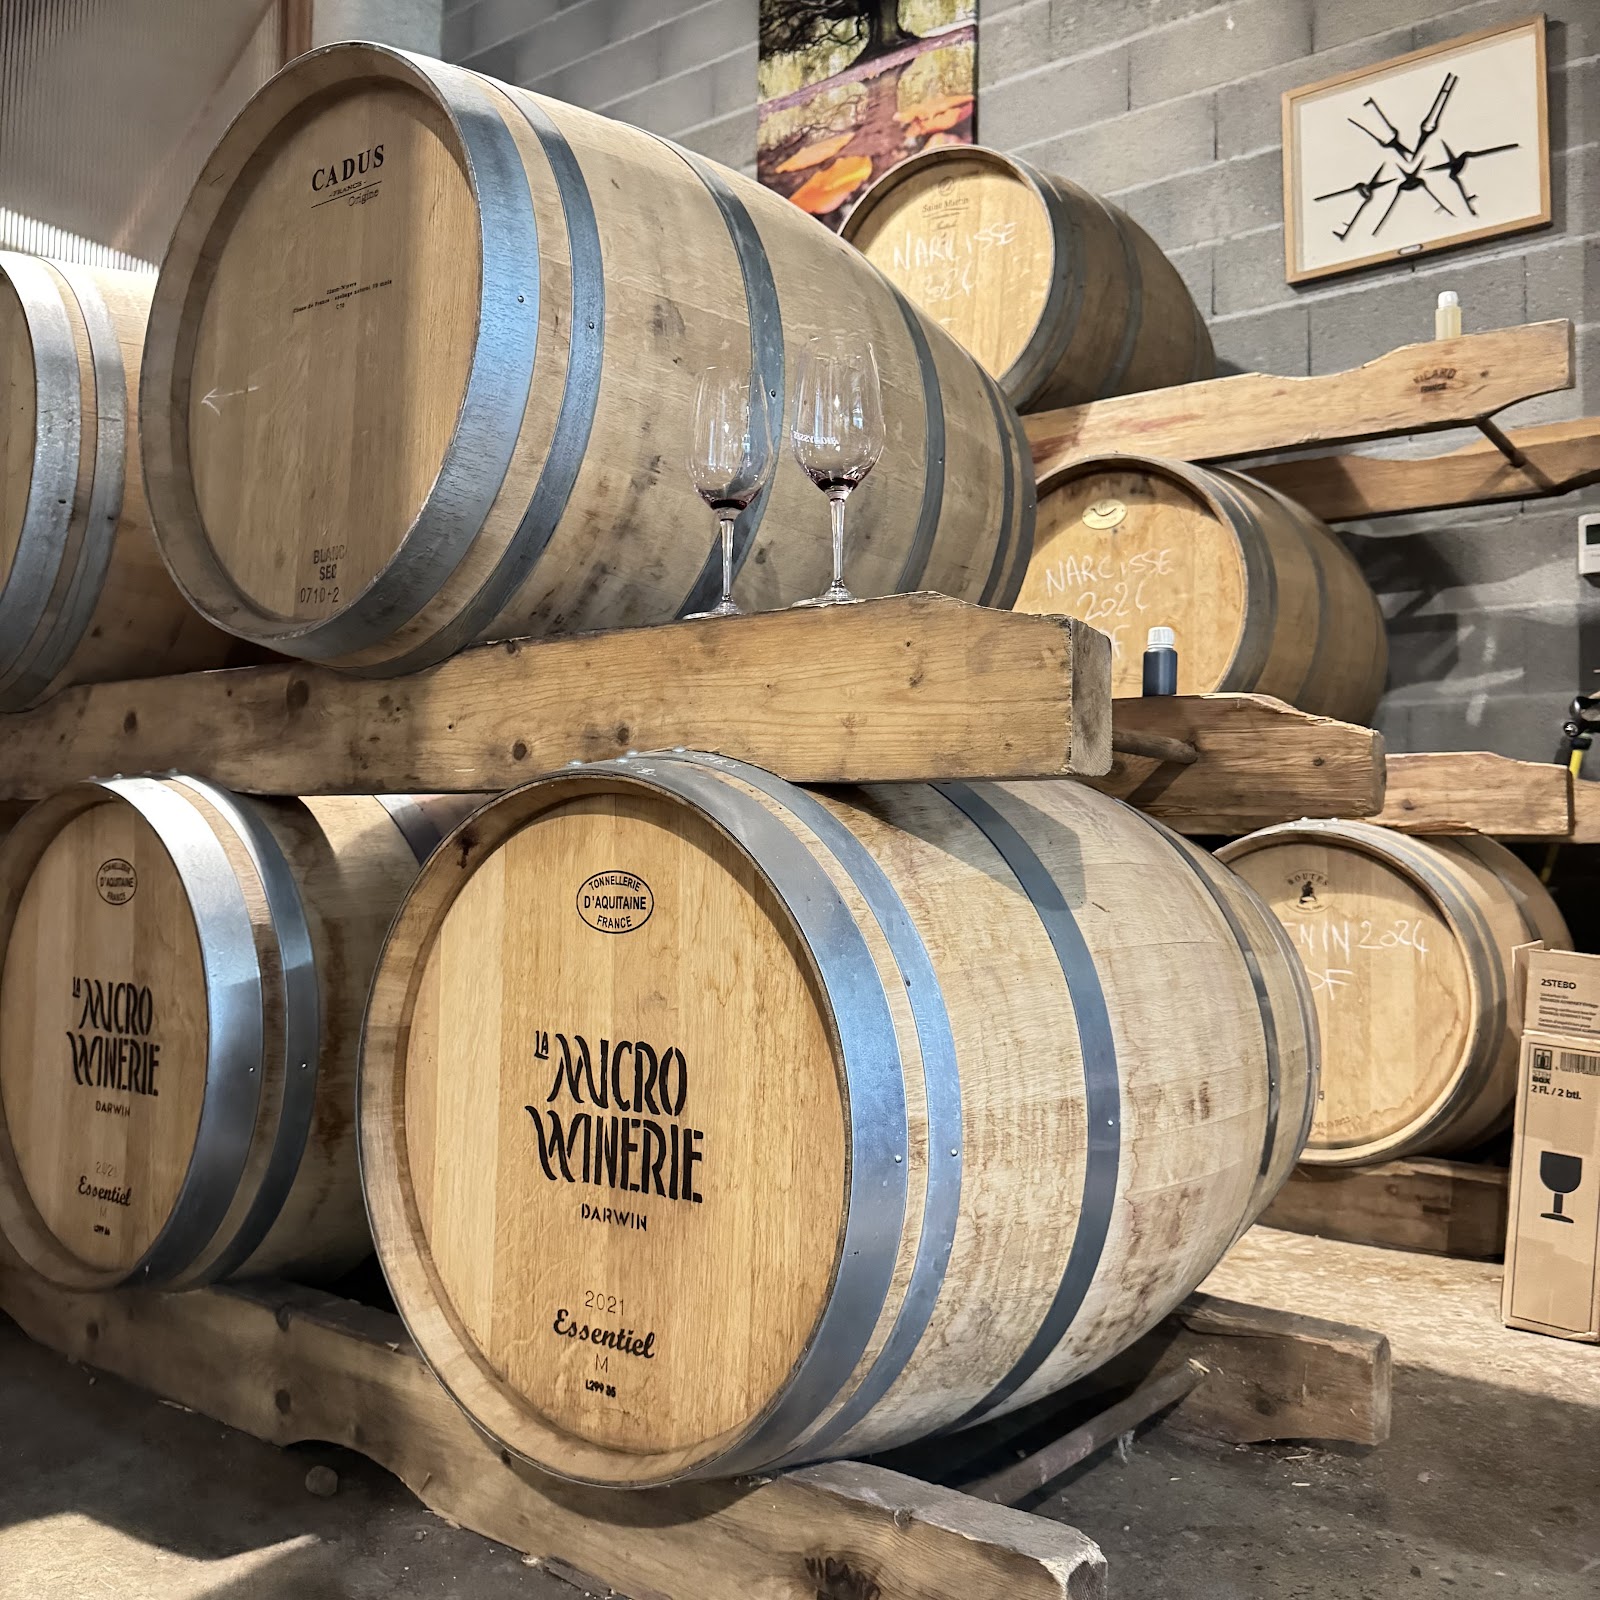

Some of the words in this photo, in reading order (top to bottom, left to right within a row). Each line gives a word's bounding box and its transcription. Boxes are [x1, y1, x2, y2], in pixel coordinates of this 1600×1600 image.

[312, 144, 384, 191] CADUS
[319, 564, 337, 581] SEC
[1046, 549, 1175, 598] NARCISSE
[588, 875, 641, 893] TONNELLERIE
[583, 895, 647, 911] D'AQUITAINE
[596, 914, 633, 929] FRANCE
[72, 976, 81, 998] LA
[79, 979, 153, 1036] MICRO
[66, 1031, 160, 1097] WINERIE
[534, 1030, 549, 1060] LA
[546, 1033, 688, 1117] MICRO
[1531, 1084, 1538, 1093] 2
[1557, 1088, 1565, 1097] 2
[95, 1100, 131, 1117] DARWIN
[524, 1105, 704, 1203] WINERIE
[78, 1175, 132, 1207] Essentiel
[581, 1203, 647, 1231] DARWIN
[585, 1290, 624, 1316] 2021
[553, 1309, 655, 1359] Essentiel
[595, 1353, 609, 1374] M
